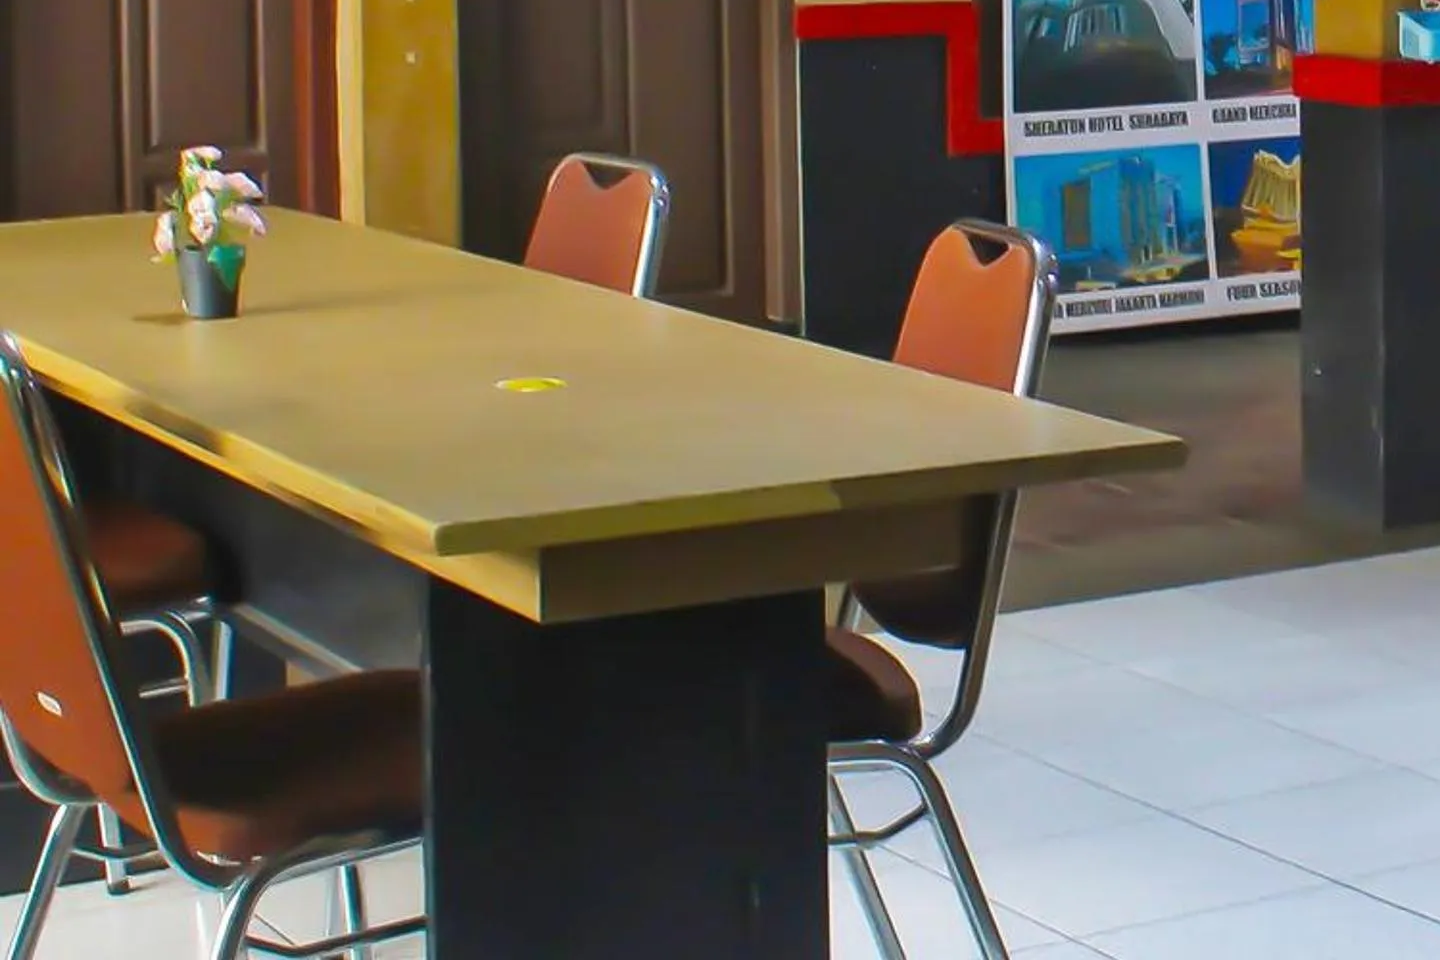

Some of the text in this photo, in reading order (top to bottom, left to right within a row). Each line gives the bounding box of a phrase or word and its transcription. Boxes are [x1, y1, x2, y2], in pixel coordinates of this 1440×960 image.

[1024, 111, 1188, 136] SHERATON HOTEL SURABAYA
[1213, 107, 1248, 123] GRAND
